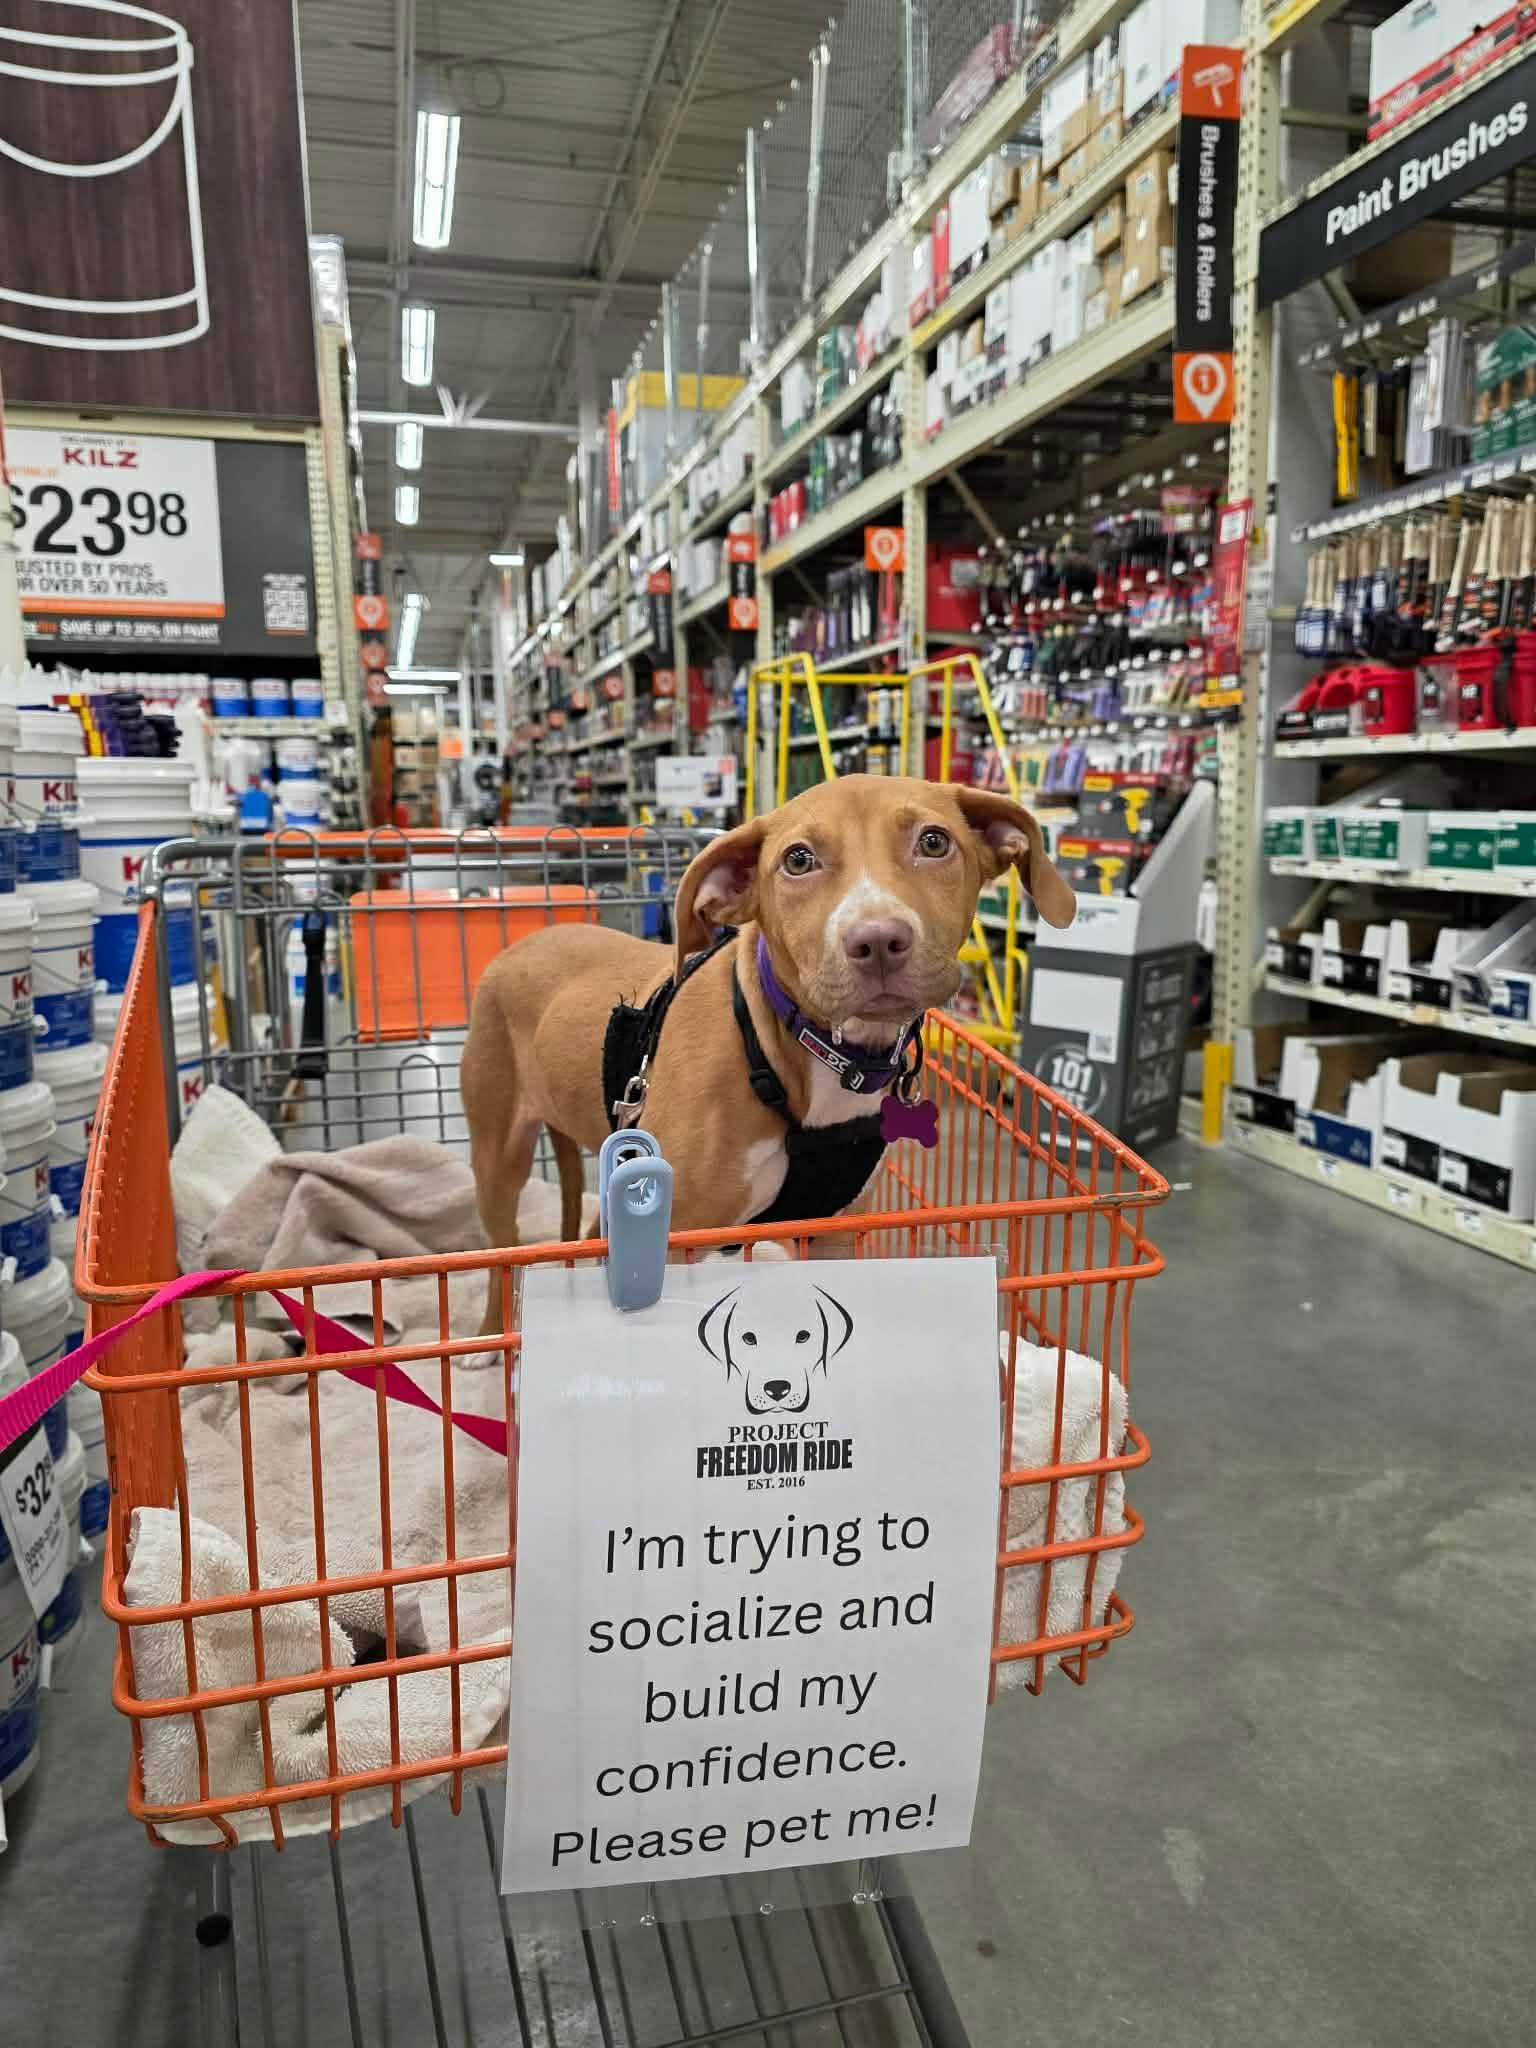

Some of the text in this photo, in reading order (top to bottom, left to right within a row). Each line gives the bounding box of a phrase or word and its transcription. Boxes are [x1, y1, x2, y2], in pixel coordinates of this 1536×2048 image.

[1325, 176, 1394, 247] Paint
[1398, 100, 1529, 203] Brushes
[1196, 124, 1221, 323] Brushes & Rollers
[62, 447, 139, 469] KILZ
[81, 562, 102, 576] BY
[1052, 1055, 1094, 1093] 101
[696, 1438, 853, 1480] FREEDOM RIDE
[728, 1421, 829, 1445] PROJECT
[746, 1475, 806, 1492] EST. 2016
[606, 1510, 931, 1575] I’m trying to
[587, 1580, 936, 1655] socialize and
[644, 1669, 879, 1725] build my
[595, 1741, 908, 1798] confidence.
[551, 1793, 939, 1868] Please pet me!
